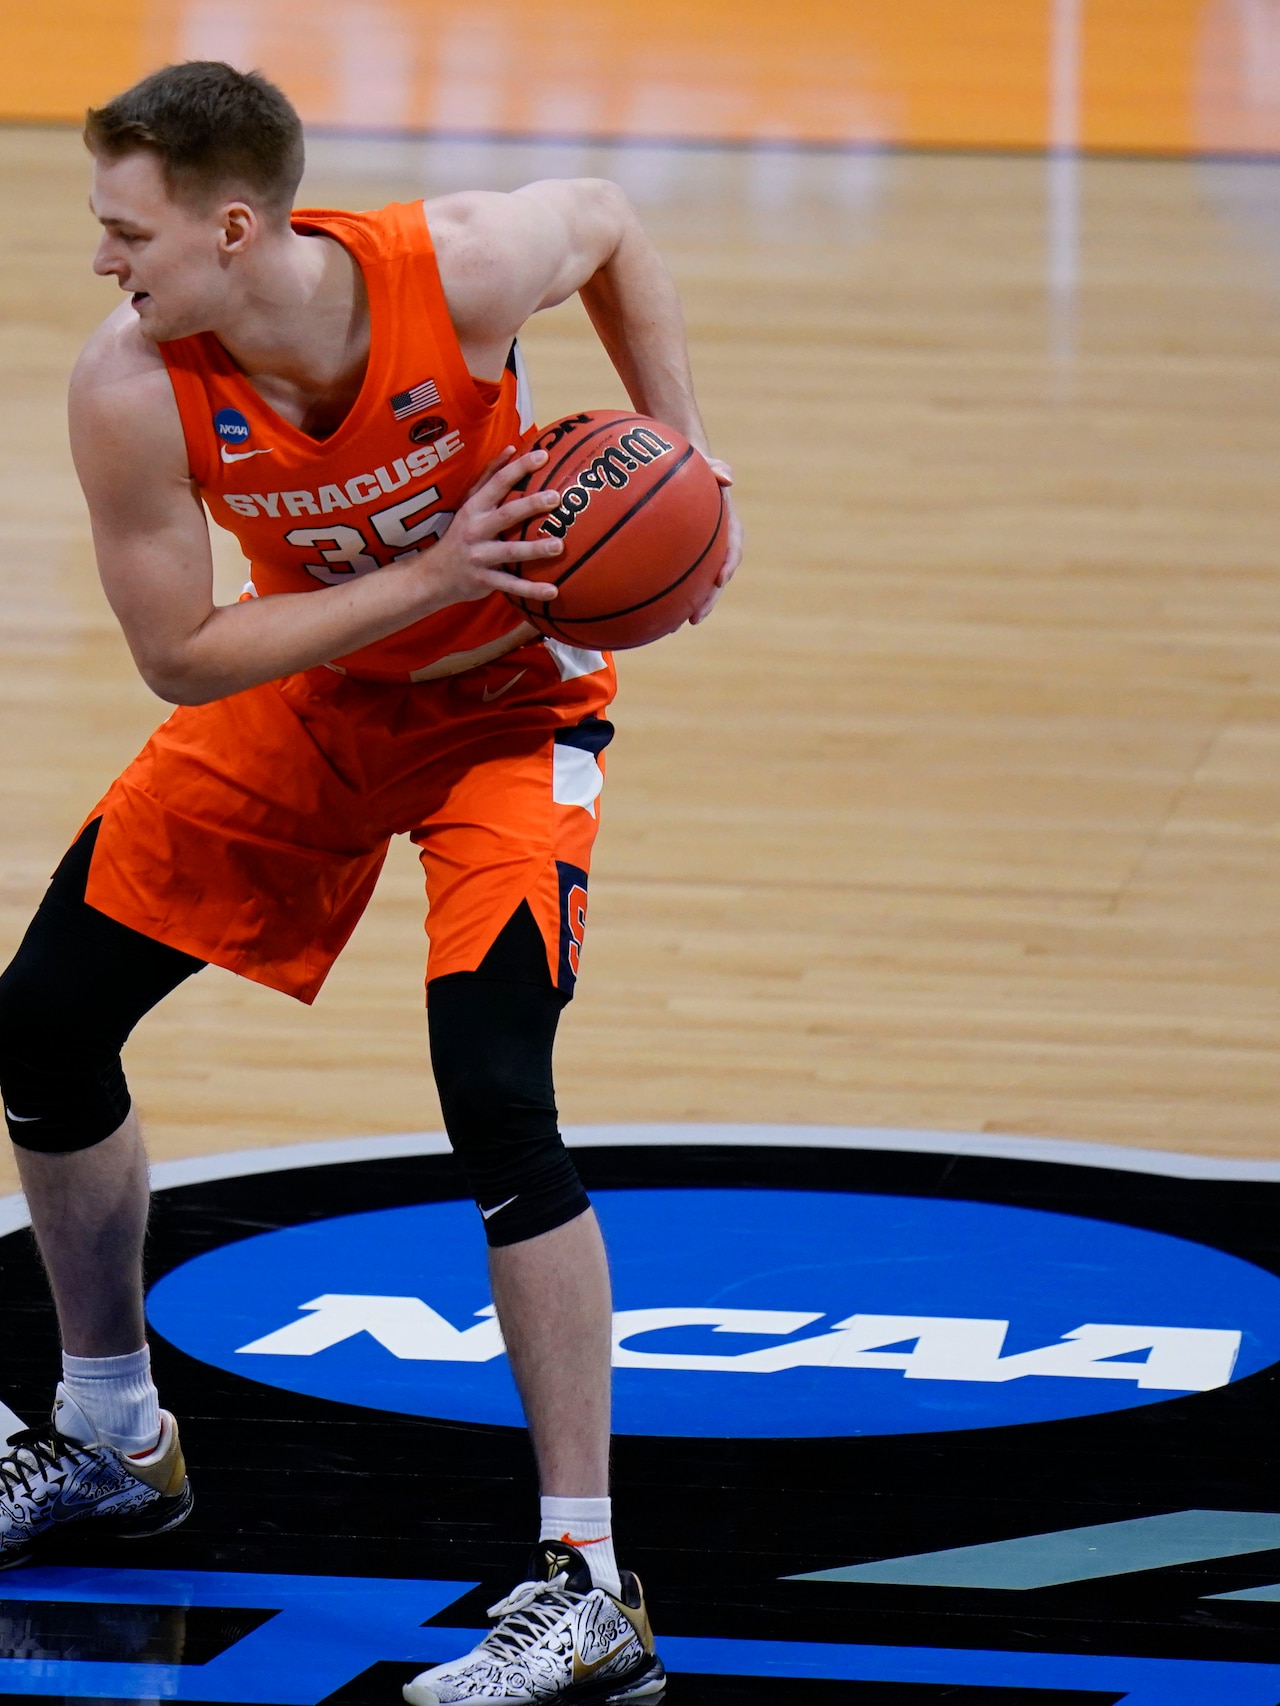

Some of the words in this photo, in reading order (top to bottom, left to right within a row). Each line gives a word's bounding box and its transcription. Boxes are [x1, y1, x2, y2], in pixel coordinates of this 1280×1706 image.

[219, 423, 249, 437] NCAA
[223, 430, 465, 519] SYRACUSE
[538, 426, 674, 540] Wilson
[285, 487, 455, 586] 35
[234, 1293, 1243, 1392] NCAA
